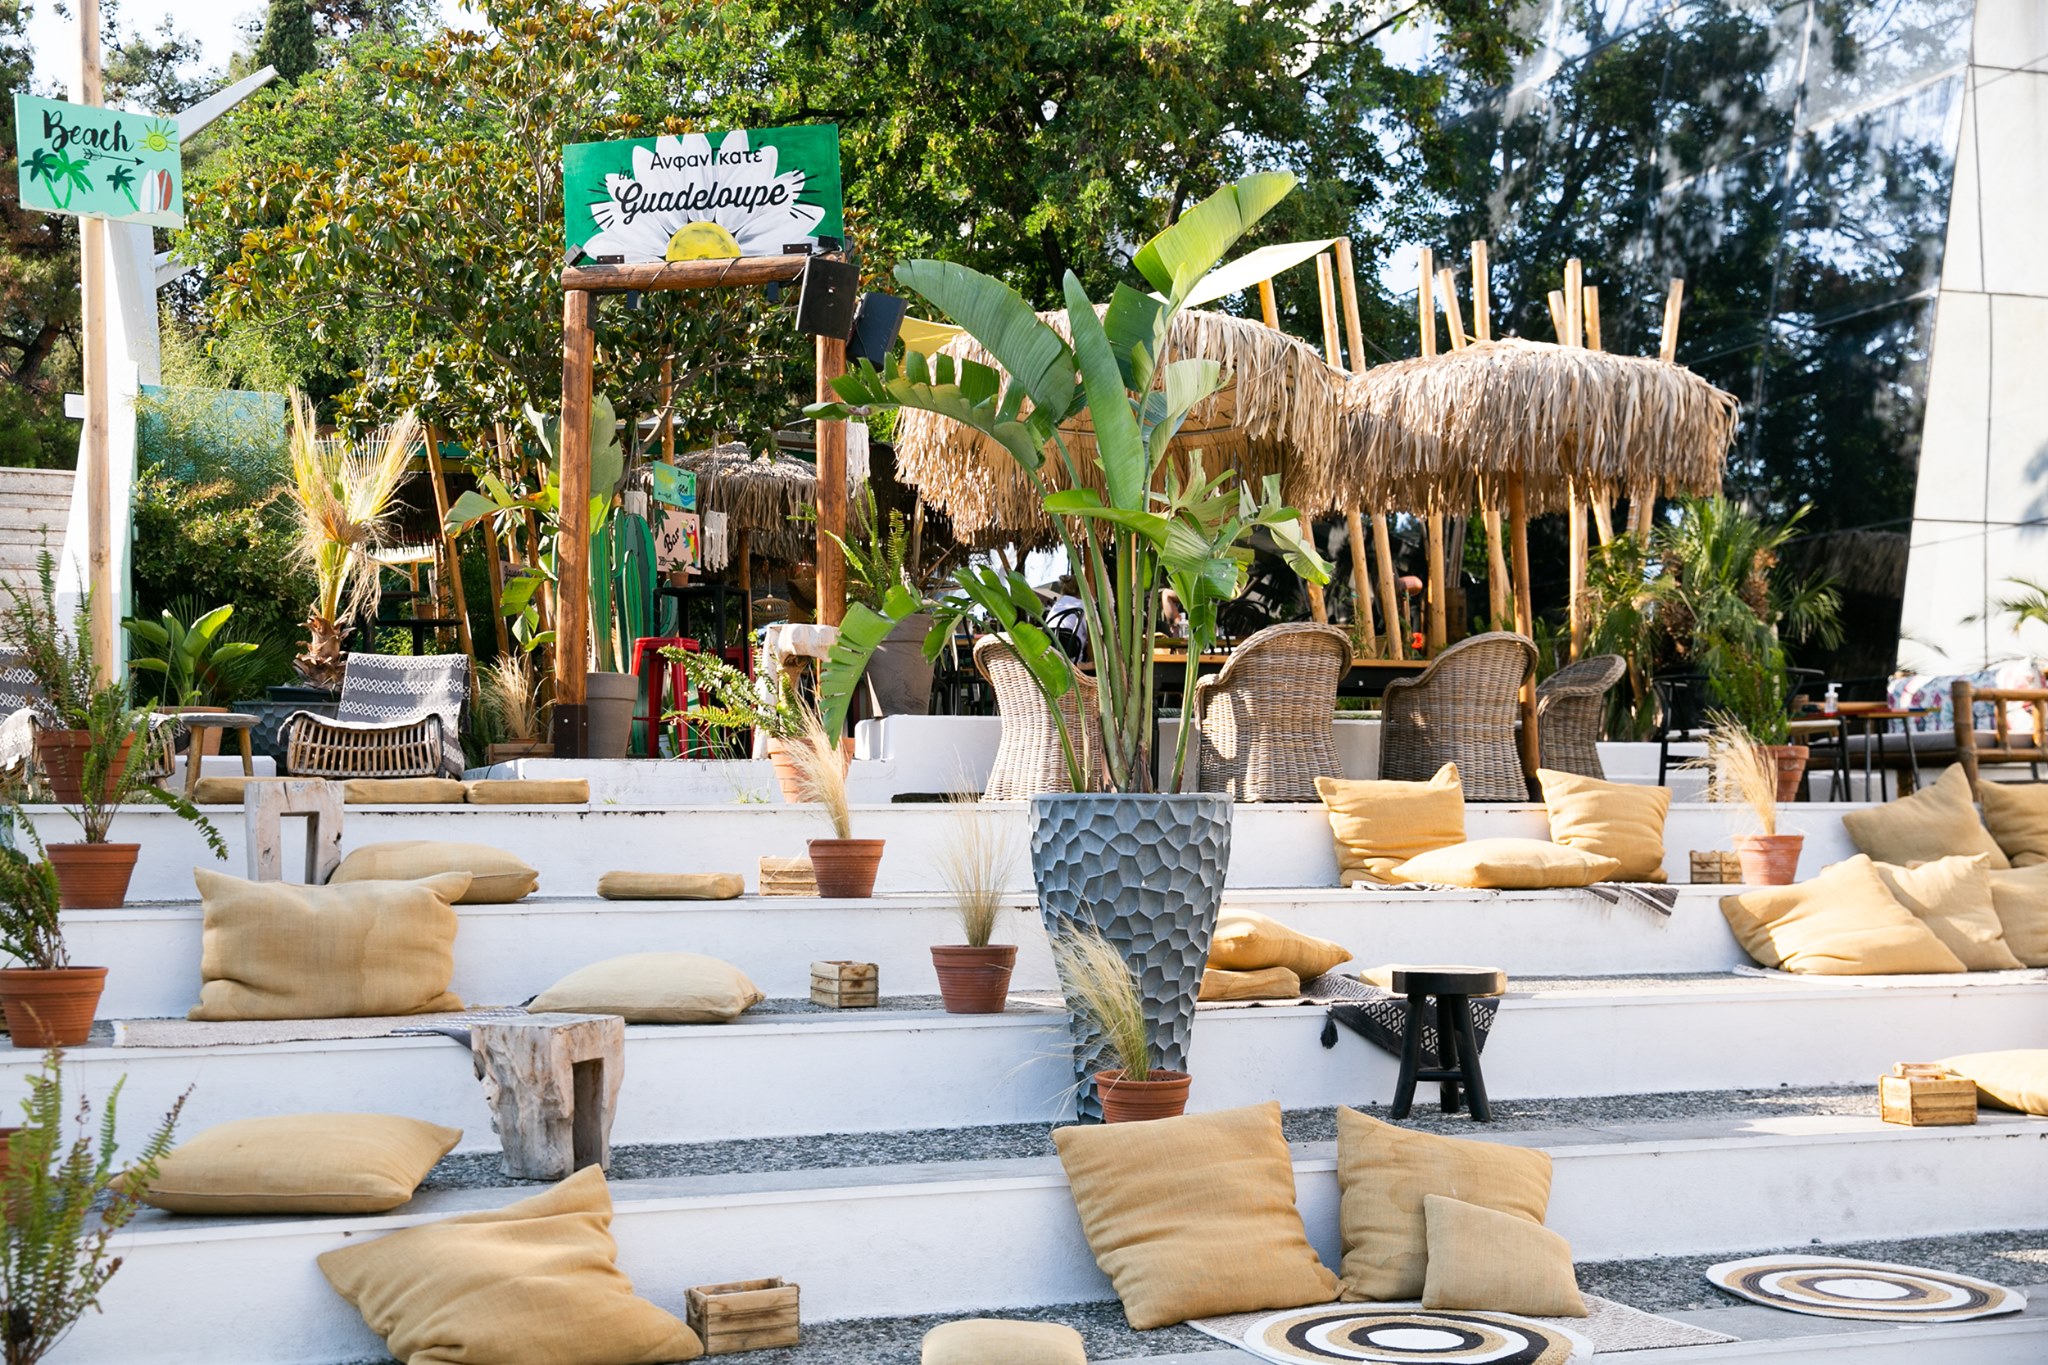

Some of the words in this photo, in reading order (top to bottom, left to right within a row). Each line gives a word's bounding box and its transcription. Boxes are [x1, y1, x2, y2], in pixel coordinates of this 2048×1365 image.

[42, 109, 135, 153] Beach
[618, 166, 633, 180] in
[615, 181, 789, 225] Guadeloupe
[664, 528, 679, 555] Bar
